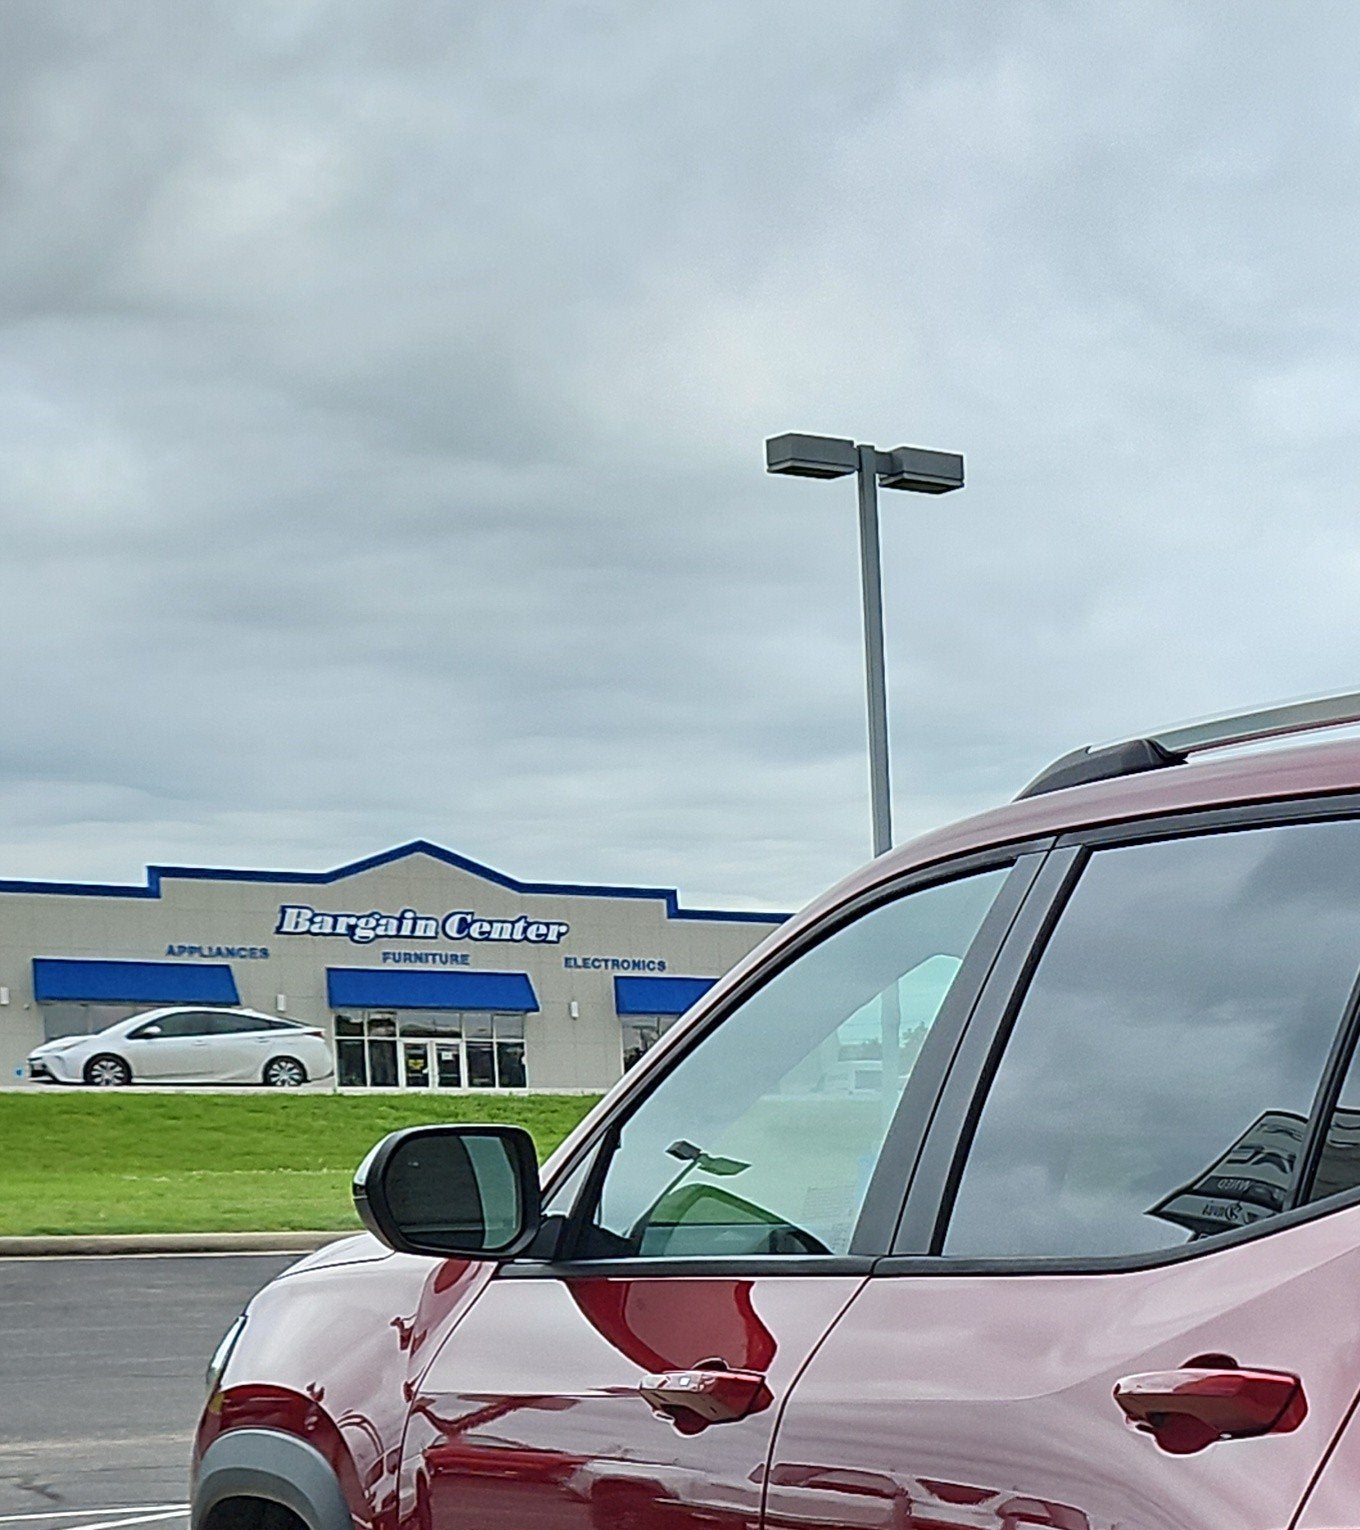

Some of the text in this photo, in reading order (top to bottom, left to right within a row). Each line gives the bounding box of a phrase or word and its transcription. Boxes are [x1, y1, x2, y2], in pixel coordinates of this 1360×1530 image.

[275, 905, 569, 944] Bargain Center
[165, 944, 270, 960] APPLIANCES
[382, 951, 470, 966] FURNITURE
[564, 956, 666, 972] ELECTRONICS
